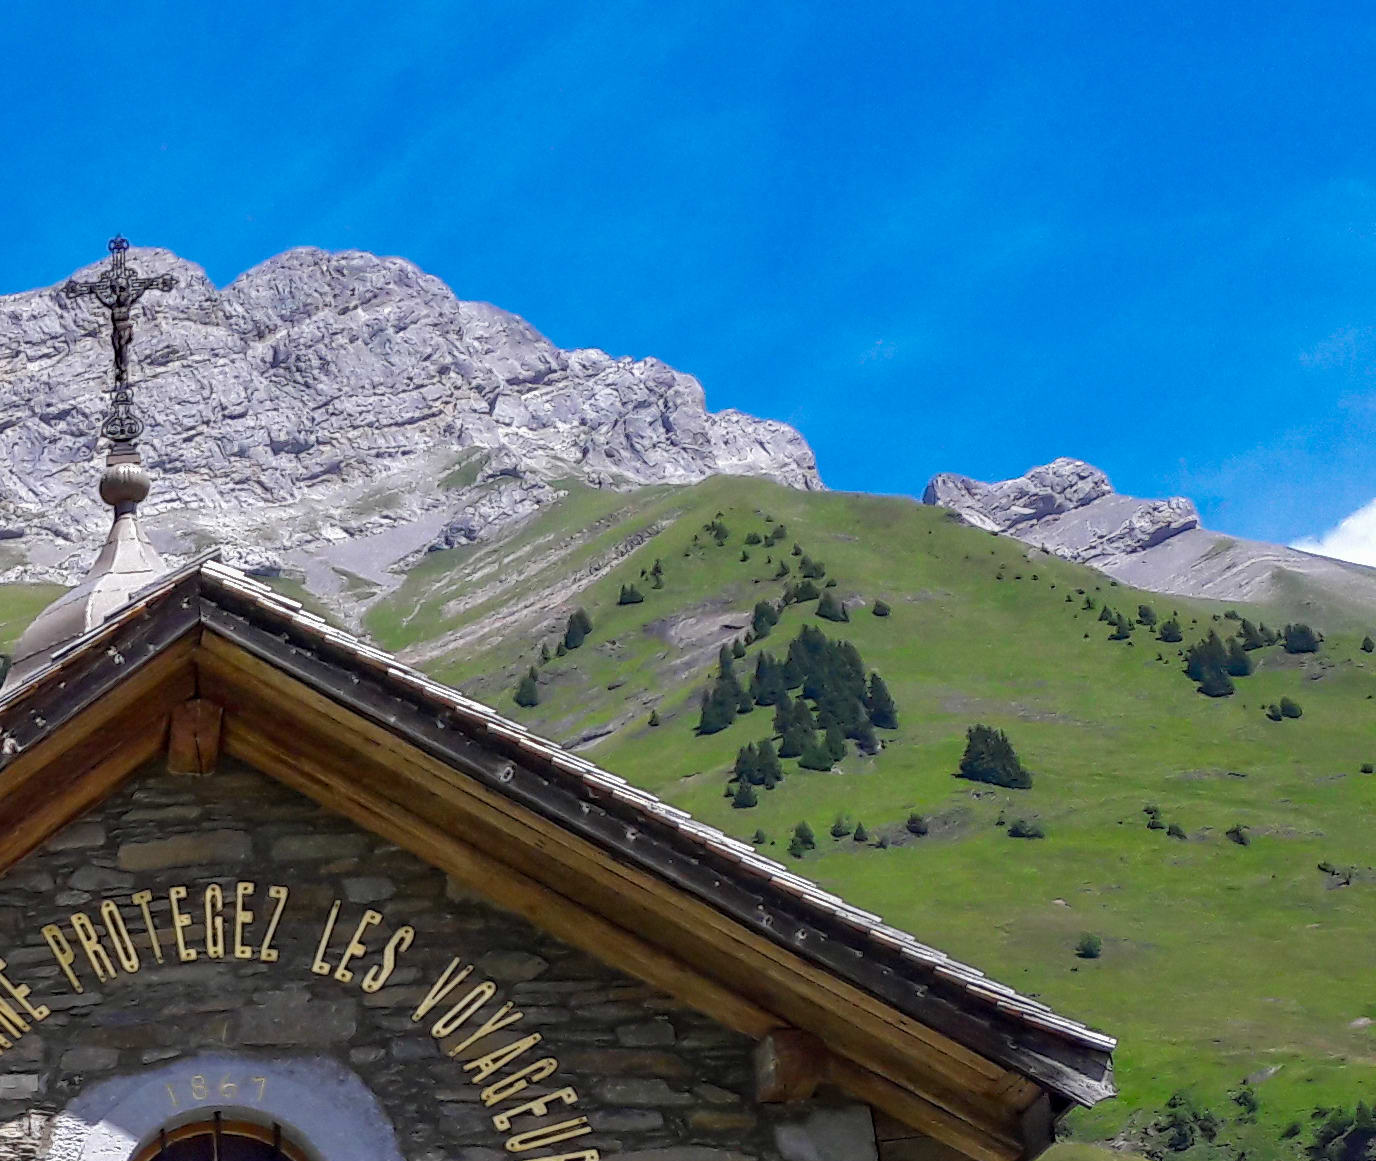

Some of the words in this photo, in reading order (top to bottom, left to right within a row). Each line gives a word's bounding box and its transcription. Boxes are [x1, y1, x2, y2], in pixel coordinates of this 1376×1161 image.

[40, 881, 290, 993] PROTEGEZ
[311, 898, 416, 993] LES
[164, 1071, 267, 1107] 1867
